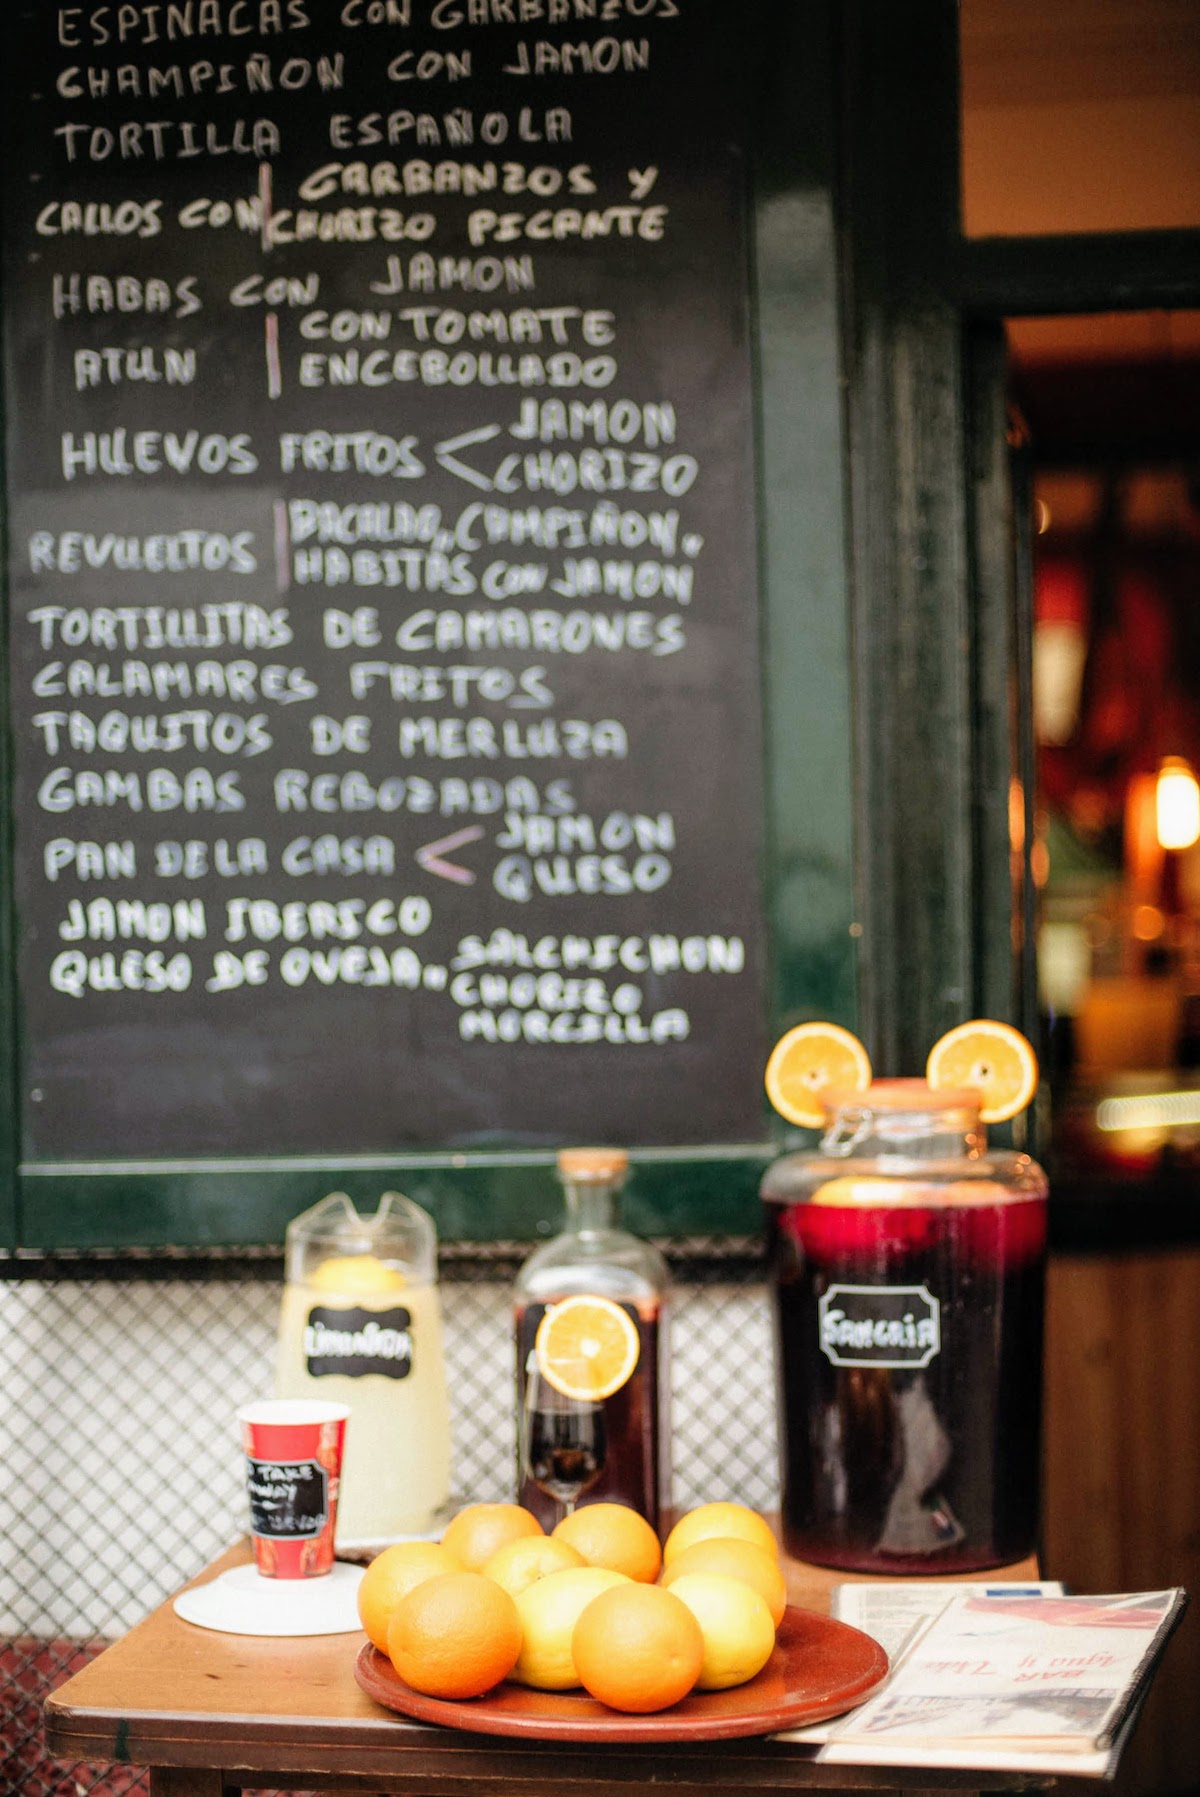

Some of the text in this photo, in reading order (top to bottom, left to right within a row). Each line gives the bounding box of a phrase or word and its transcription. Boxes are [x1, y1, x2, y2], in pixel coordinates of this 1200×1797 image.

[58, 0, 310, 46] ESPINACAS
[341, 0, 410, 28] CON
[387, 50, 472, 82] CON
[501, 37, 650, 76] JAMON
[54, 106, 573, 162] TORTILLA ESPAÑOLA
[299, 159, 597, 201] GARBANZOS
[35, 199, 163, 238] CALLOS
[178, 194, 266, 233] CON
[467, 204, 669, 247] PICANTE
[52, 251, 536, 319] HABAS CON JAMON
[300, 305, 617, 347] CON TOMATE
[74, 347, 198, 392] ATUN
[300, 348, 618, 389] ENCEBOLLADO
[508, 397, 677, 447] JAMON
[60, 427, 427, 482] HUEVOS FRITOS
[493, 446, 699, 497] CHORIZO
[27, 529, 258, 575] REVUELTOS
[293, 545, 477, 596] HABITAS
[549, 555, 696, 606] JAMON
[322, 606, 383, 649] DE
[396, 607, 688, 657] CAMARONES
[32, 658, 557, 709] CALAMARES FRITOS
[32, 709, 630, 760] TAQUITOS DE MERLUZA
[37, 765, 578, 818] GAMBAS REBOZADAS
[44, 833, 397, 882] PAN DE LA CASA
[495, 810, 677, 857] JAMON
[493, 853, 672, 902] QUESO
[58, 895, 432, 943] JAMON IBERICO
[49, 949, 193, 998] QUESO
[205, 949, 271, 994] DE
